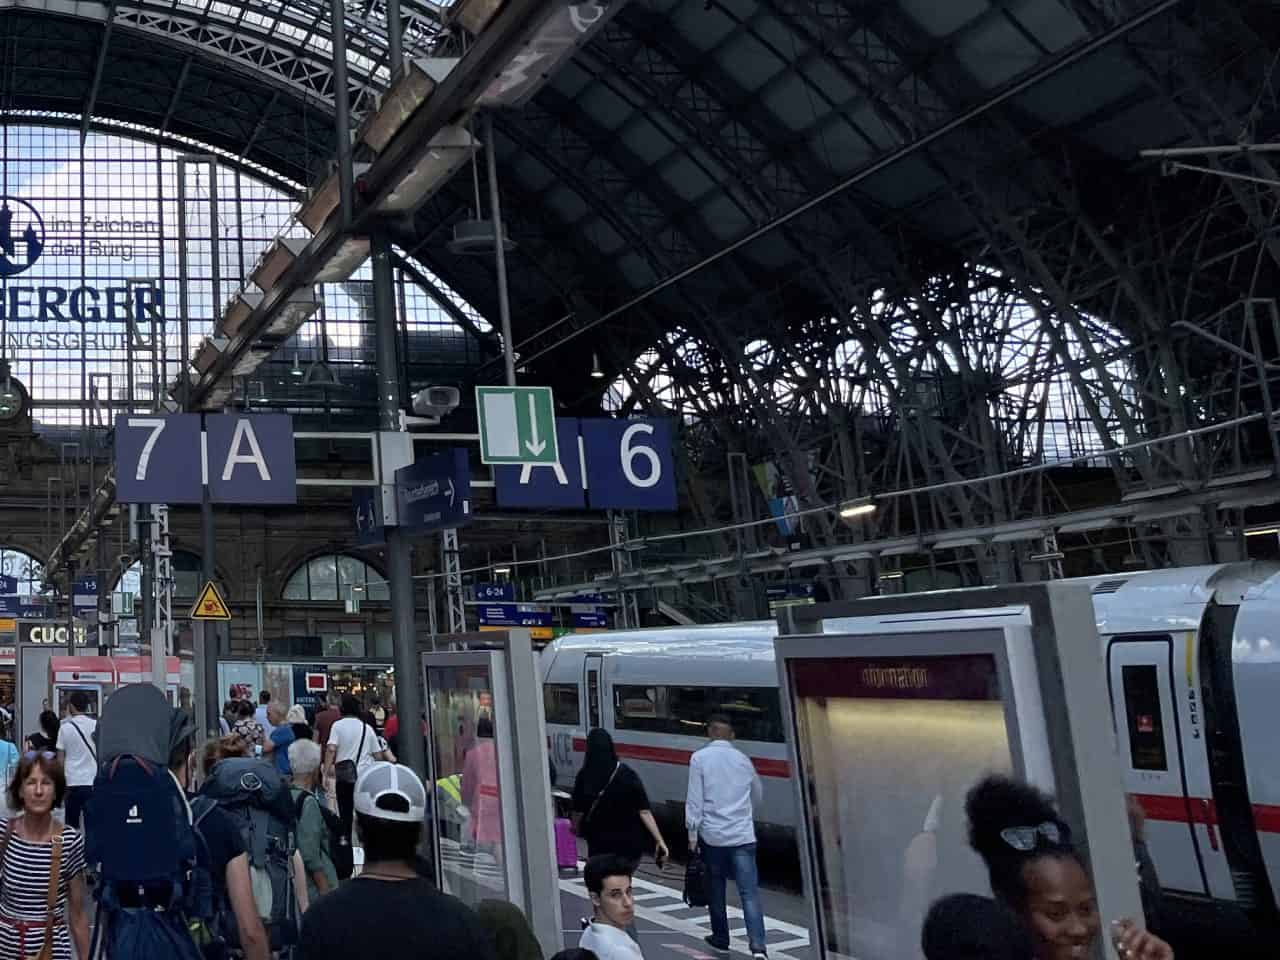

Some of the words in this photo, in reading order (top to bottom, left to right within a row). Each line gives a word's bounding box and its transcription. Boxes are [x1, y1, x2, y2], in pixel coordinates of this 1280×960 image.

[88, 240, 134, 262] Burg
[128, 418, 166, 481] 7
[222, 419, 271, 481] A
[620, 423, 661, 488] 6
